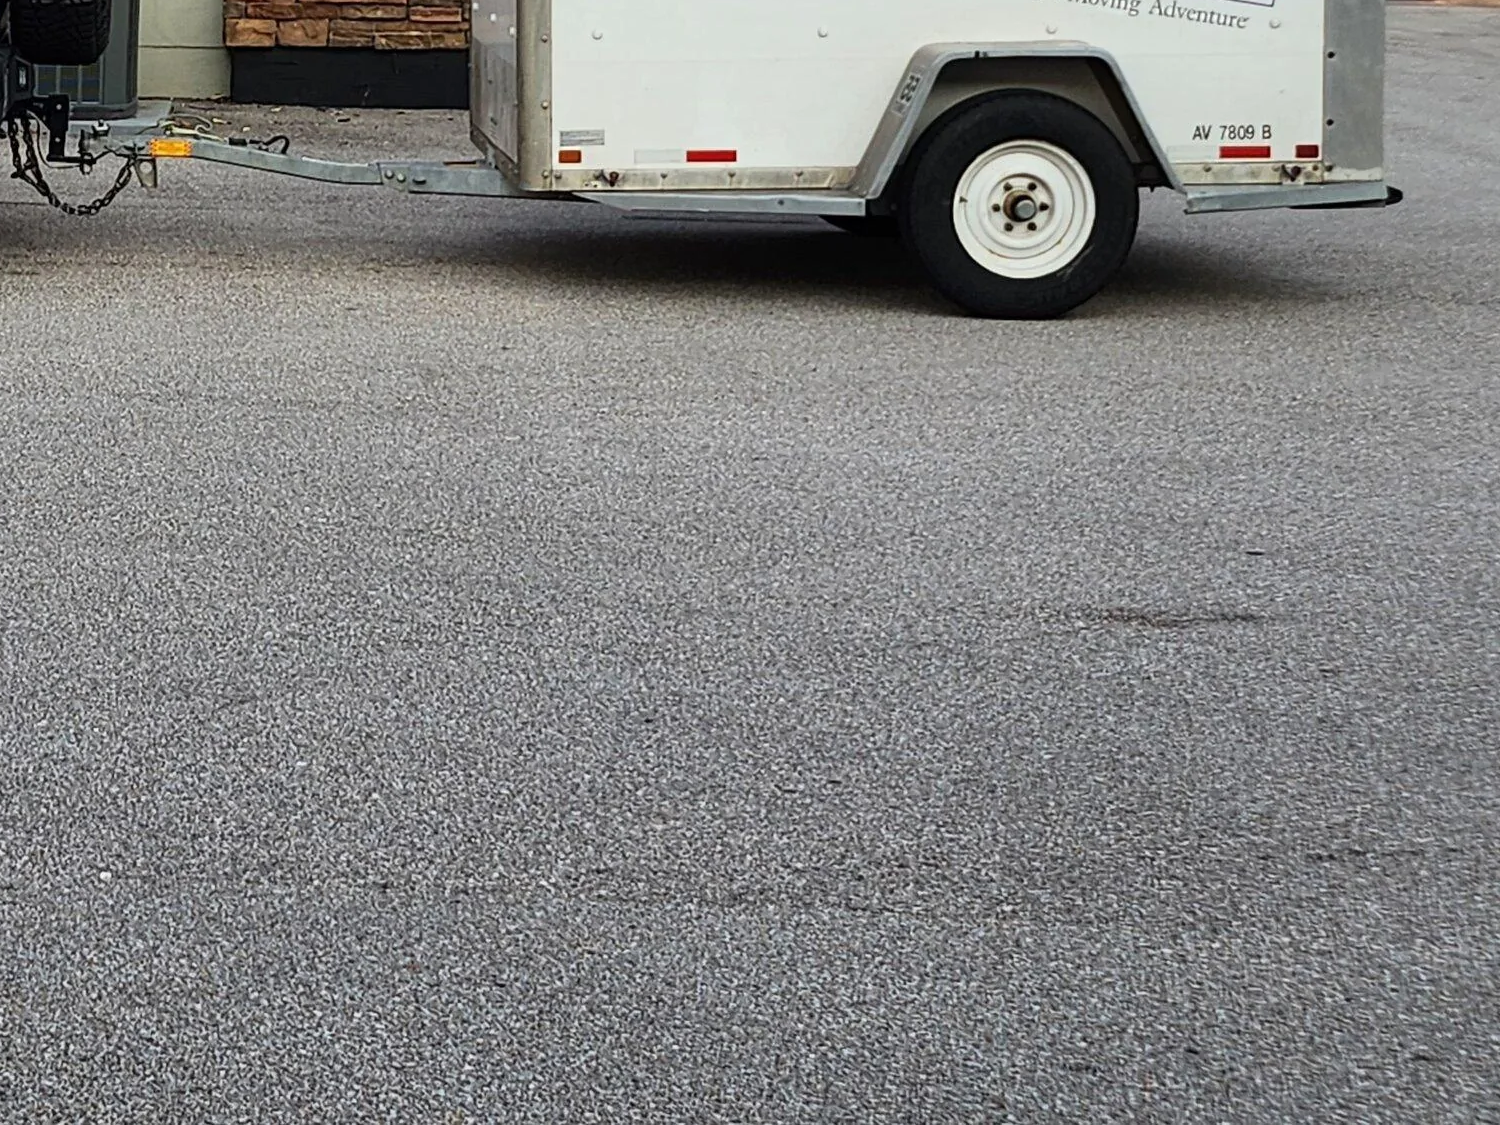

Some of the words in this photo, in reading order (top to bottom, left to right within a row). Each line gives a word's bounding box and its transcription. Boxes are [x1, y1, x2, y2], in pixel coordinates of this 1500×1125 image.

[1192, 124, 1212, 141] AV
[1219, 124, 1255, 140] 7809
[1262, 124, 1272, 140] B
